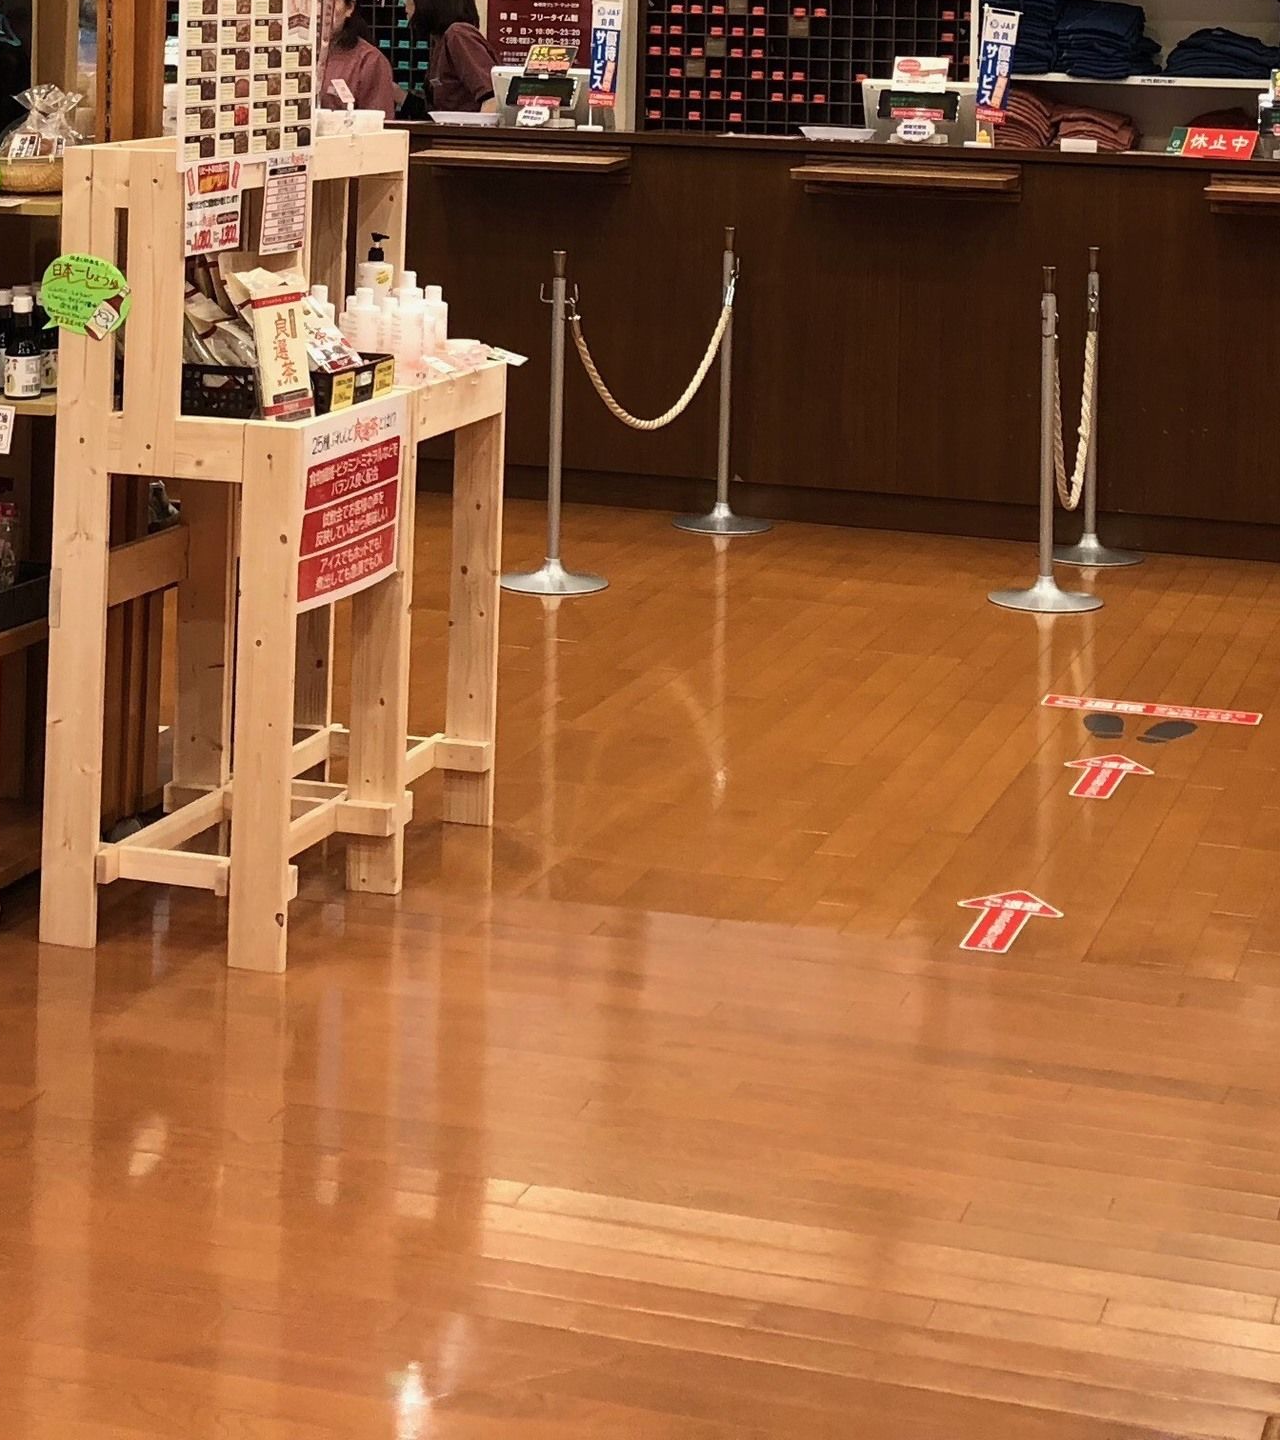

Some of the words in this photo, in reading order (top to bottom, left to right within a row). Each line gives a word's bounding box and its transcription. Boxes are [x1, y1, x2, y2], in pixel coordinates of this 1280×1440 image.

[992, 31, 1009, 41] 会員
[1000, 22, 1016, 31] JAF
[592, 30, 606, 91] サービス
[979, 44, 999, 105] サービス
[1190, 132, 1249, 152] 休止中
[272, 311, 299, 388] 良選茶
